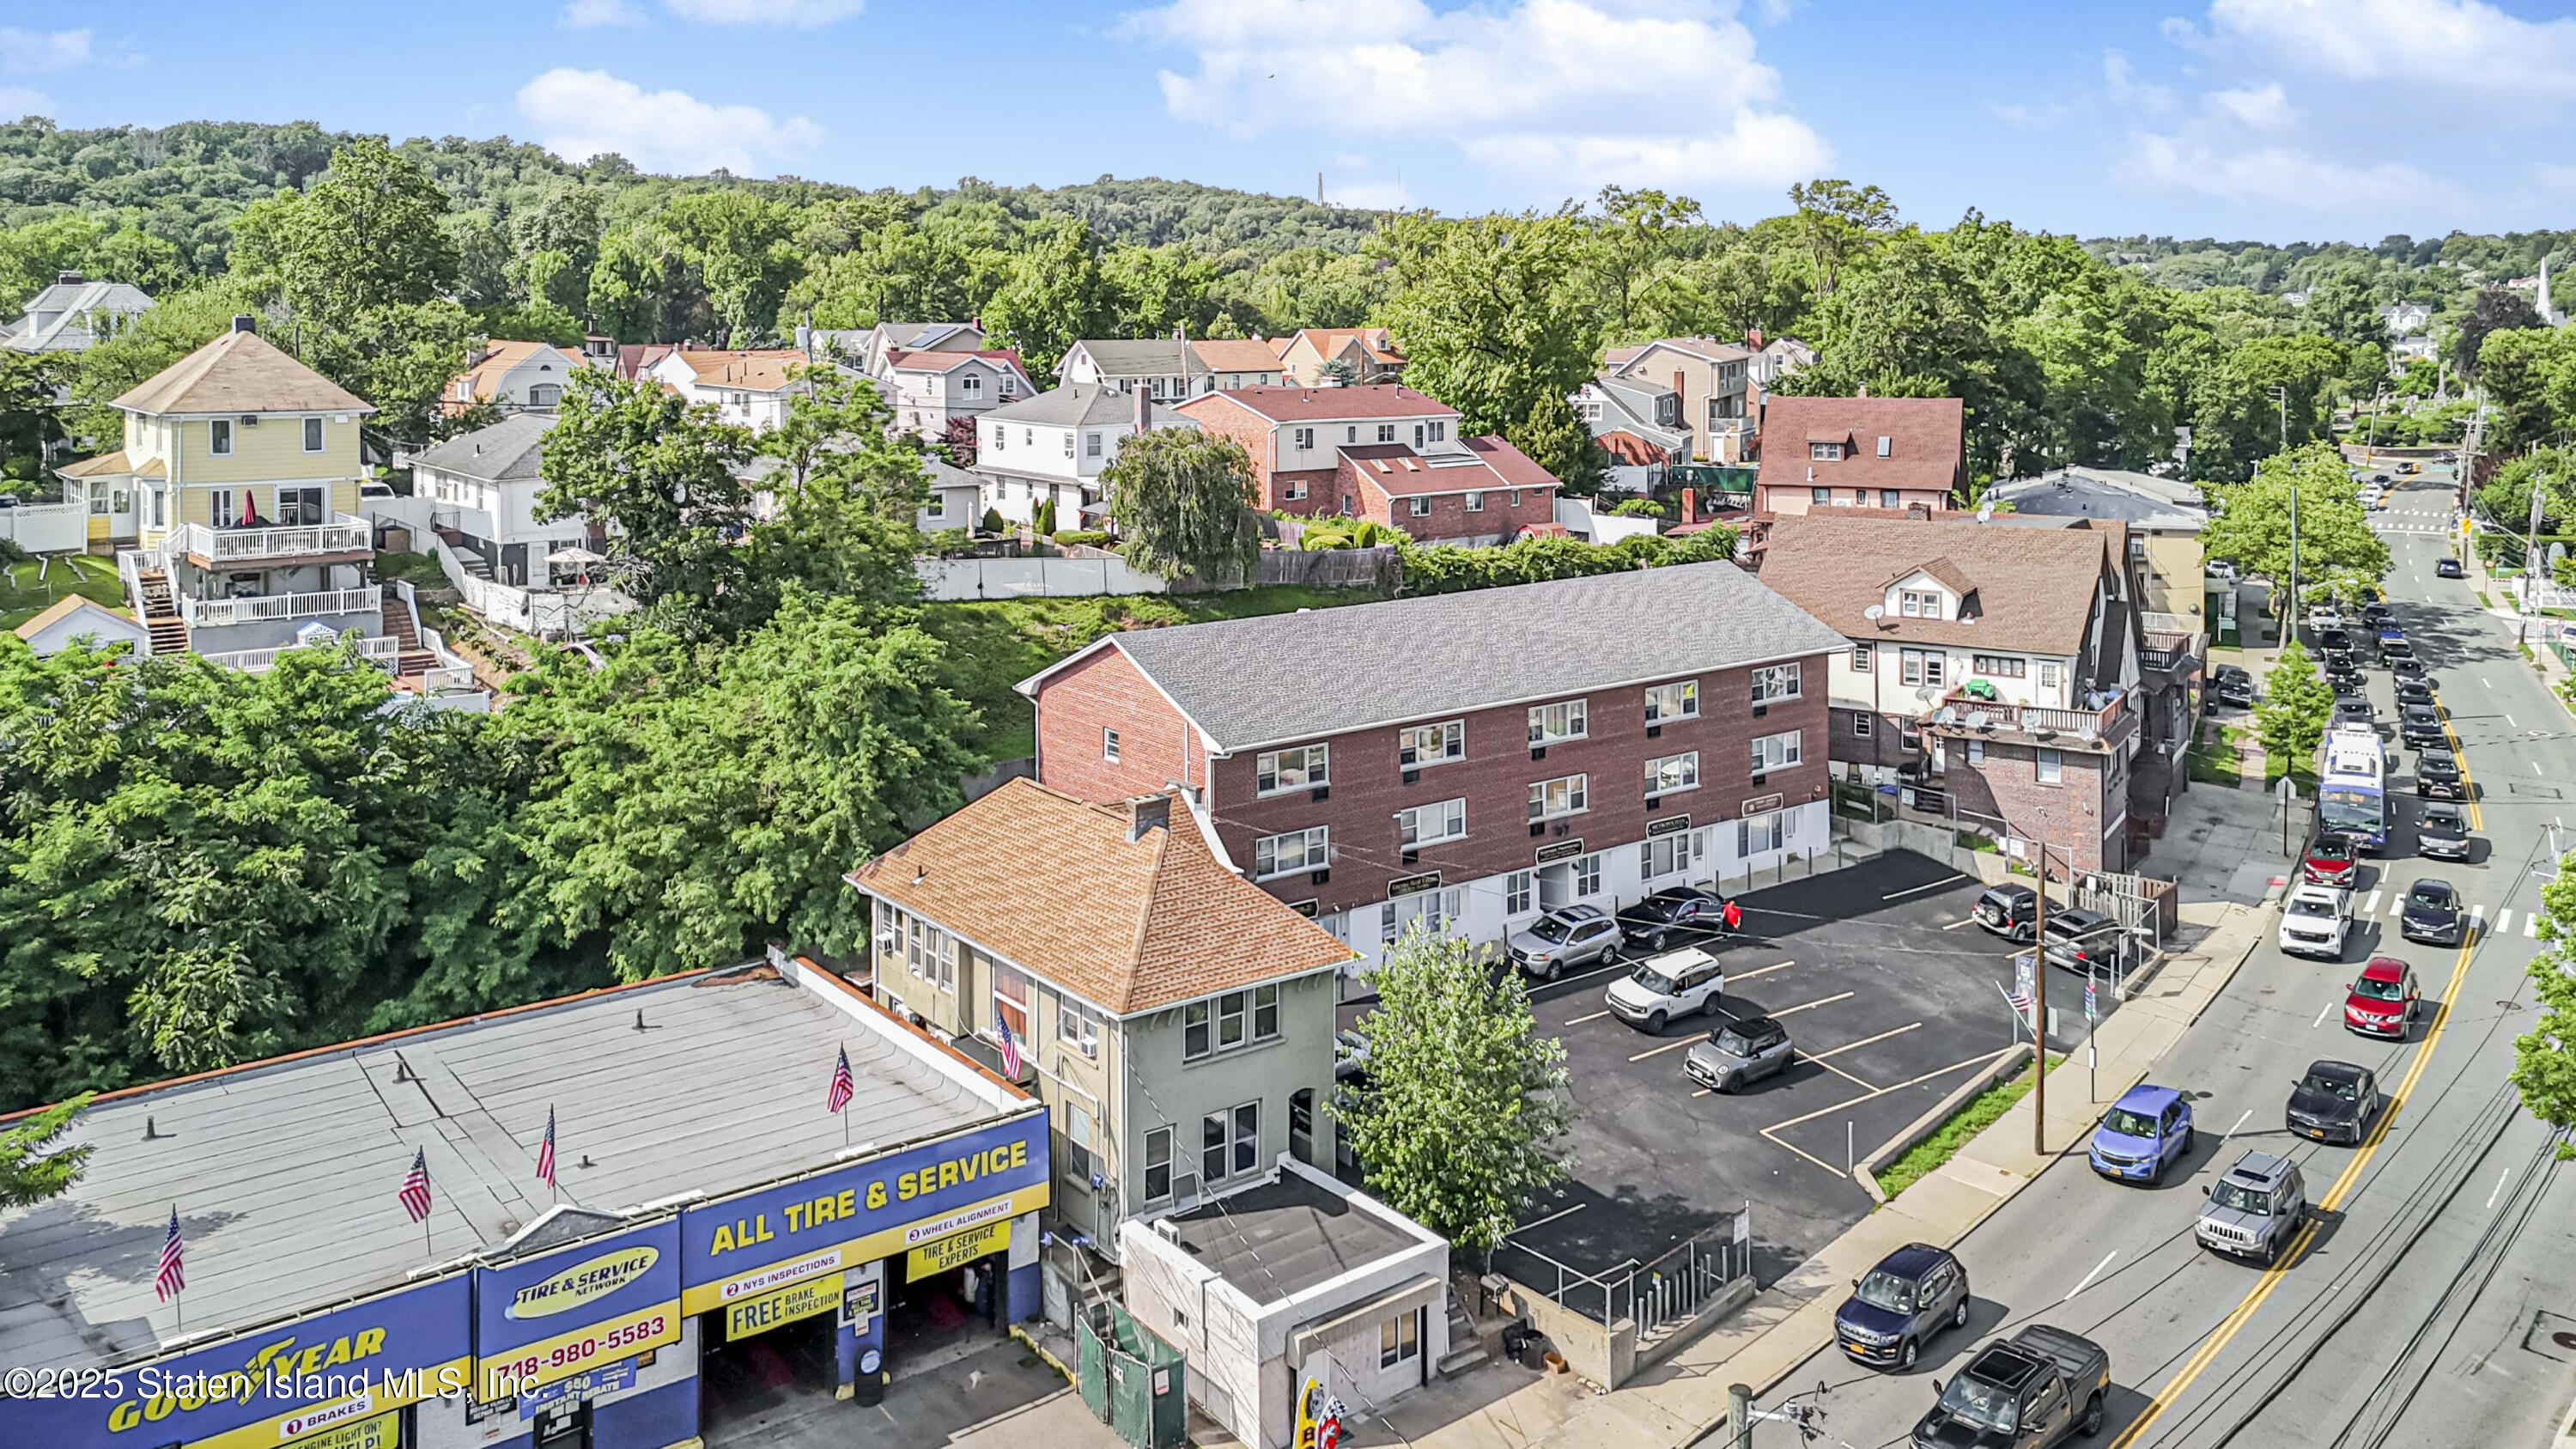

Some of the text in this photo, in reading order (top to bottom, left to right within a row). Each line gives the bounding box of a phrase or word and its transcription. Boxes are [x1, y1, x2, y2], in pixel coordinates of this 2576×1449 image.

[711, 1141, 1027, 1257] ALL TIRE & SERVICE
[922, 1221, 954, 1237] WHEEL
[957, 1202, 1010, 1226] ALIGNMENT
[923, 1243, 944, 1260] TIRE
[957, 1225, 996, 1249] SERVICE
[939, 1245, 979, 1269] EXPERTS
[519, 1255, 650, 1305] TIRE & SERVICE
[575, 1275, 627, 1298] NETWORK
[744, 1277, 764, 1292] NYS
[768, 1256, 835, 1284] INSPECTIONS
[785, 1287, 815, 1306] BRAKE
[785, 1290, 841, 1318] INSPECTION
[732, 1296, 783, 1334] FREE
[496, 1316, 665, 1382] 718-980-5583
[563, 1375, 591, 1393] $50
[307, 1401, 366, 1427] BRAKES
[535, 1391, 581, 1415] INSTANT
[335, 1435, 380, 1449] LP!
[336, 1427, 361, 1444] LIGHT
[364, 1421, 382, 1435] ON?
